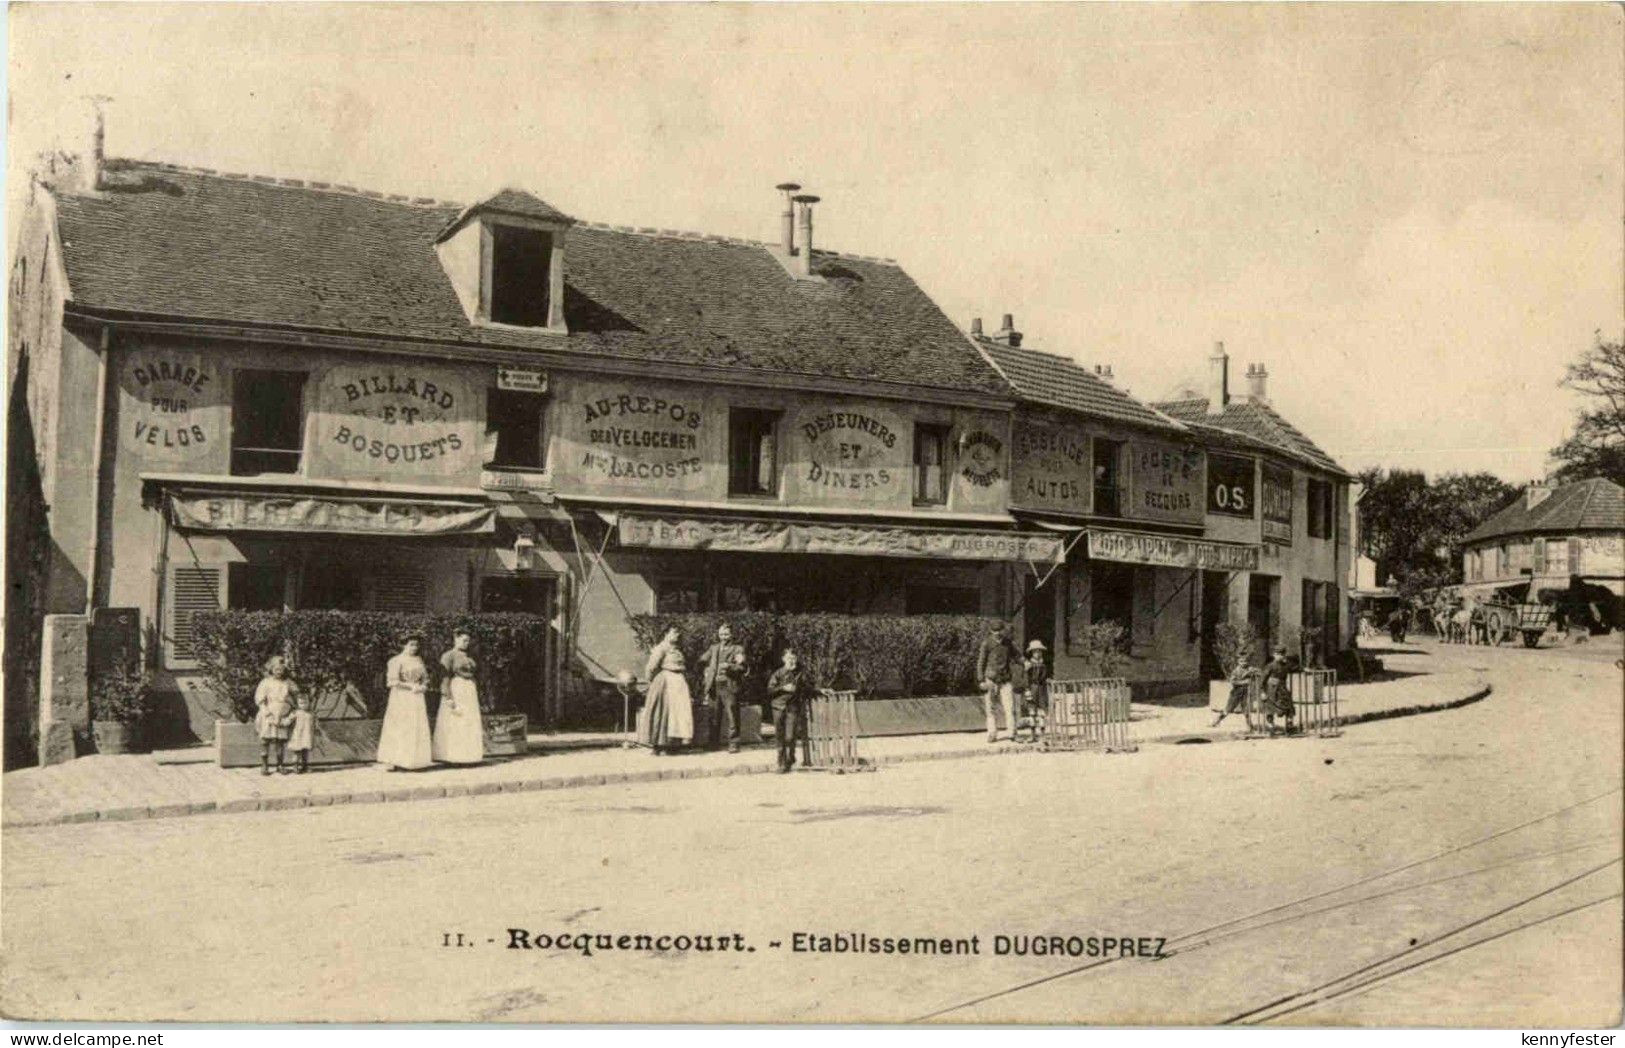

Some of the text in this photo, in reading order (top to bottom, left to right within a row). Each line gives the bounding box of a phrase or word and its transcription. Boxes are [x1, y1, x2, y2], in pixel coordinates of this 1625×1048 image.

[133, 361, 210, 393] GARAGE
[342, 375, 454, 410] BILLARD
[152, 398, 188, 413] POUR
[383, 405, 420, 426] ET
[333, 425, 462, 464] BOSQUETS
[840, 443, 861, 459] ET
[608, 457, 702, 479] LACOSTE
[1027, 478, 1079, 499] AUTOS
[1145, 491, 1192, 511] SECOURS
